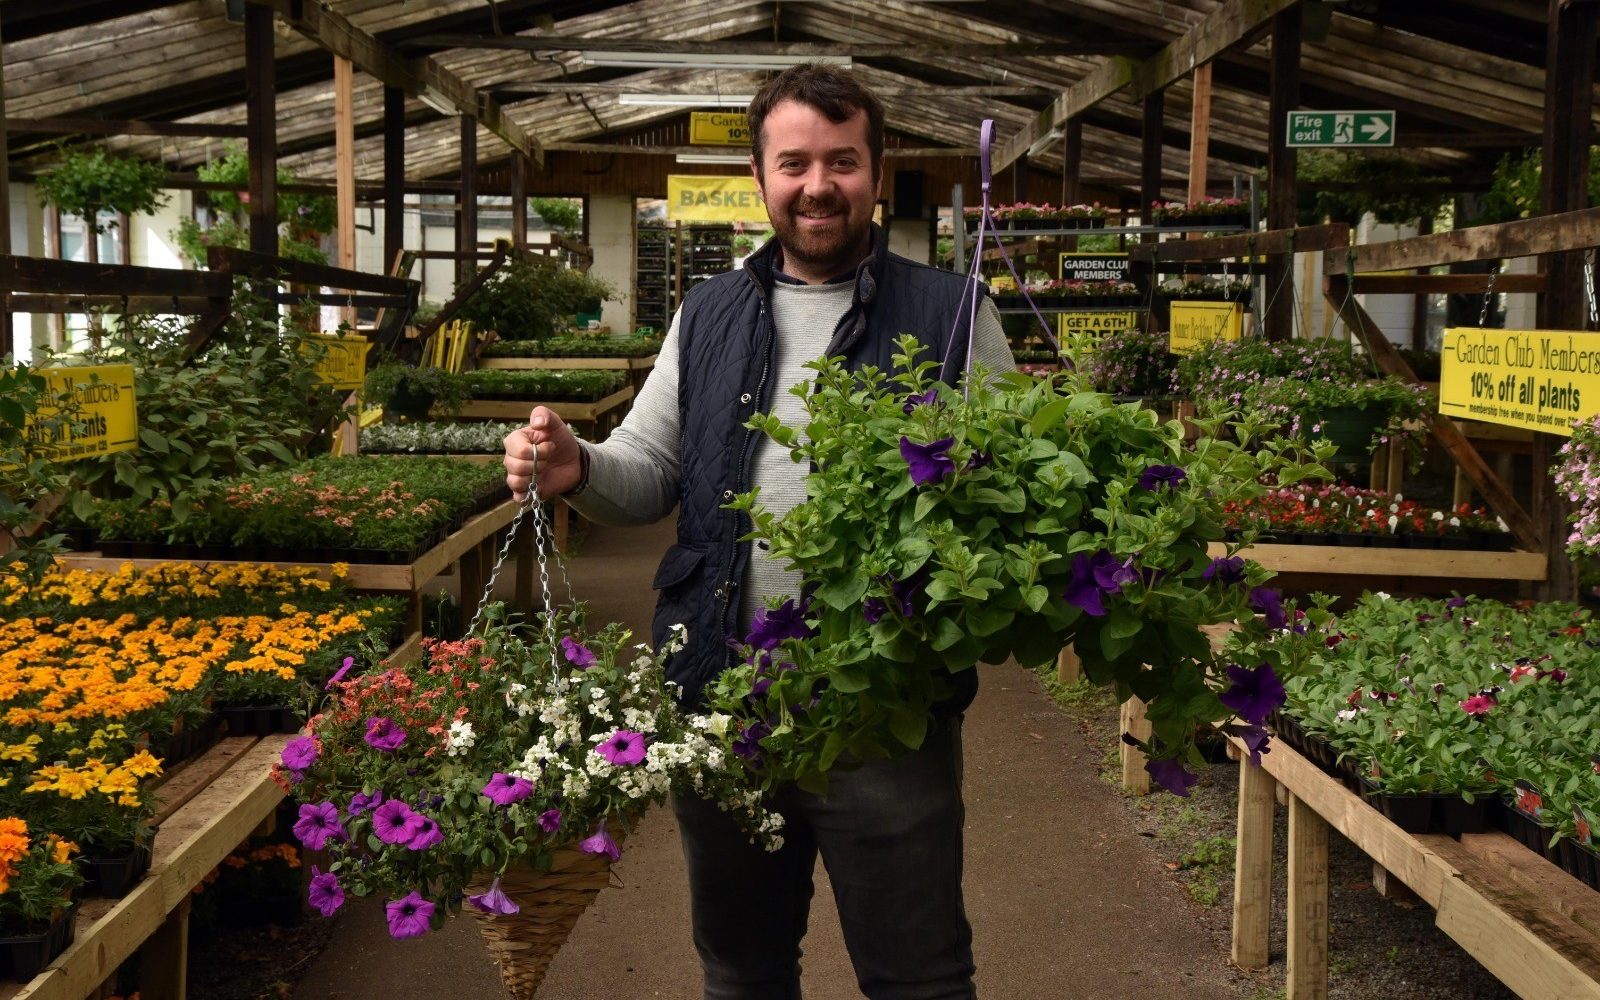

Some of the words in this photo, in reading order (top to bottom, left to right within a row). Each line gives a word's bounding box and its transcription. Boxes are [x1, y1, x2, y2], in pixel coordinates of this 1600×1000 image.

[1295, 115, 1322, 127] Fire
[1295, 129, 1321, 141] exit
[1064, 260, 1105, 269] GARDEN
[1073, 270, 1122, 279] MEMBERS
[1067, 317, 1090, 327] GET
[1093, 317, 1101, 327] A
[1103, 317, 1127, 327] 6TH
[1456, 333, 1499, 365] Garden
[1505, 334, 1534, 368] Club
[1539, 336, 1600, 375] Members
[1471, 372, 1494, 400] 10%
[1498, 374, 1516, 402] off
[1519, 377, 1534, 405] all
[1538, 378, 1580, 412] plants
[1469, 403, 1498, 416] membership
[1499, 406, 1509, 417] free
[1511, 408, 1524, 420] when
[1525, 412, 1536, 424] you
[1537, 413, 1553, 426] spend
[1554, 416, 1566, 427] over
